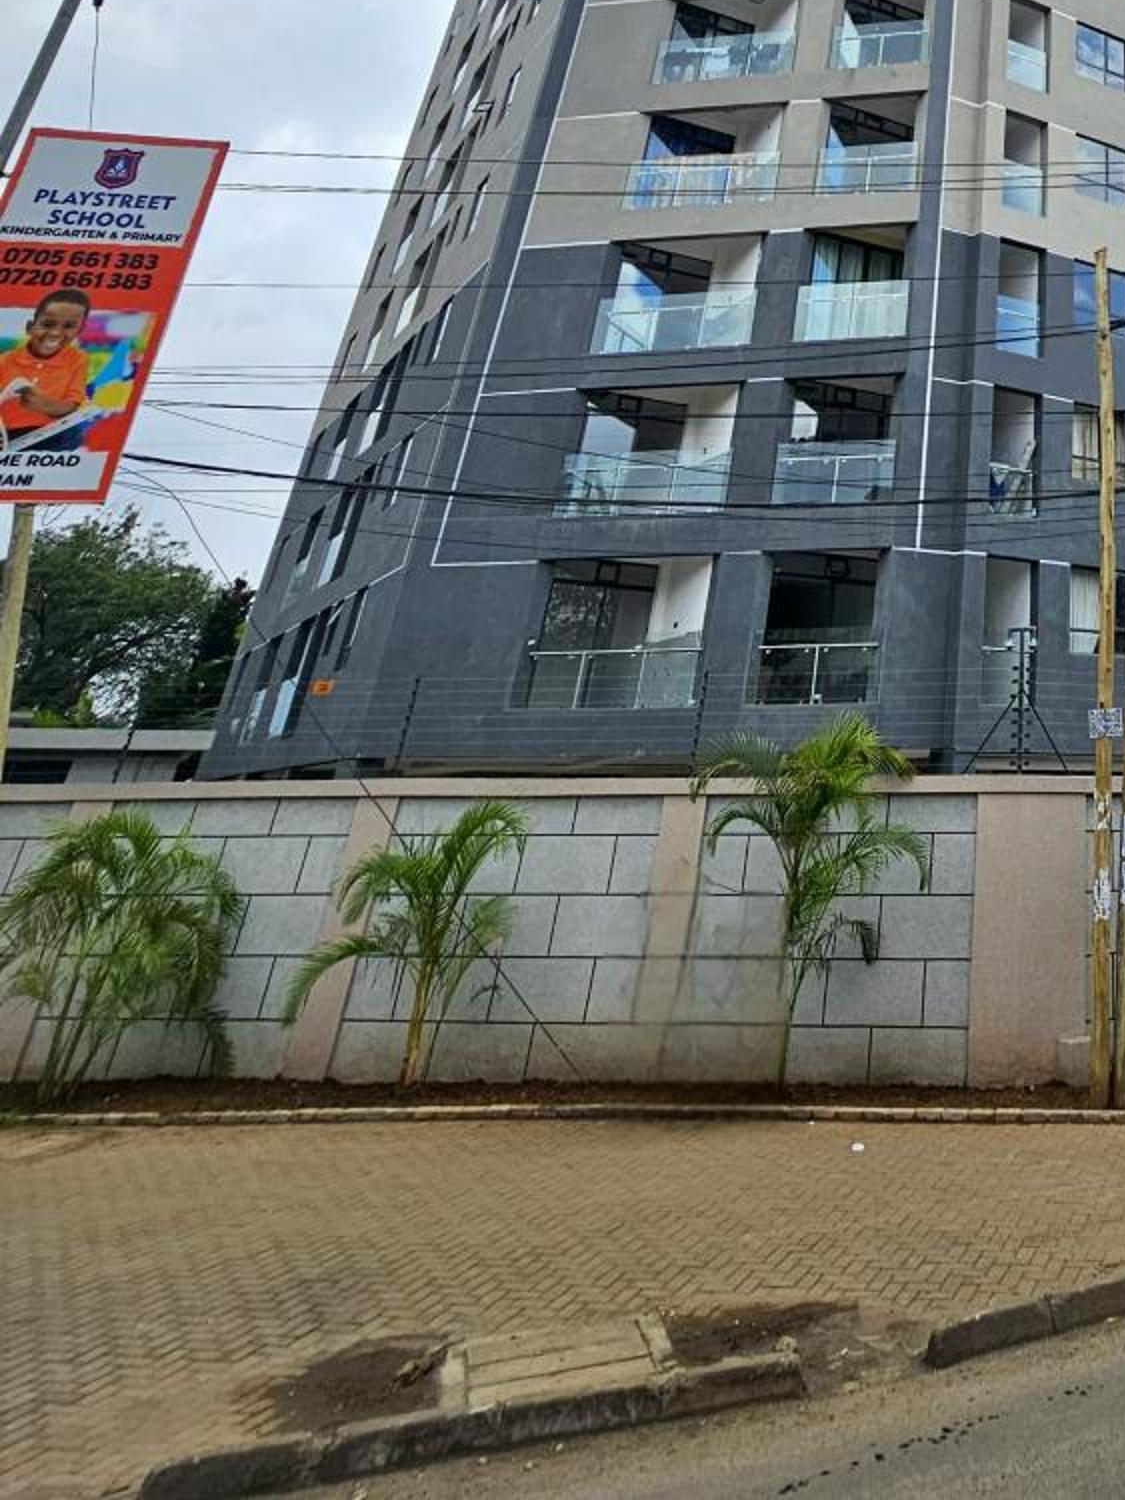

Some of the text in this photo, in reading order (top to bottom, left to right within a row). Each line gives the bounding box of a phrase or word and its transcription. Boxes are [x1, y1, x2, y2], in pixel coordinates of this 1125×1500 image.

[34, 188, 176, 211] PLAYSTREET
[47, 209, 145, 229] SCHOOL
[0, 225, 182, 243] KINDERGARTEN & PRIMARY
[3, 247, 160, 271] 0705 661 383
[0, 267, 154, 291] 0720 661 383
[26, 454, 81, 467] ROAD
[0, 473, 34, 487] ANI
